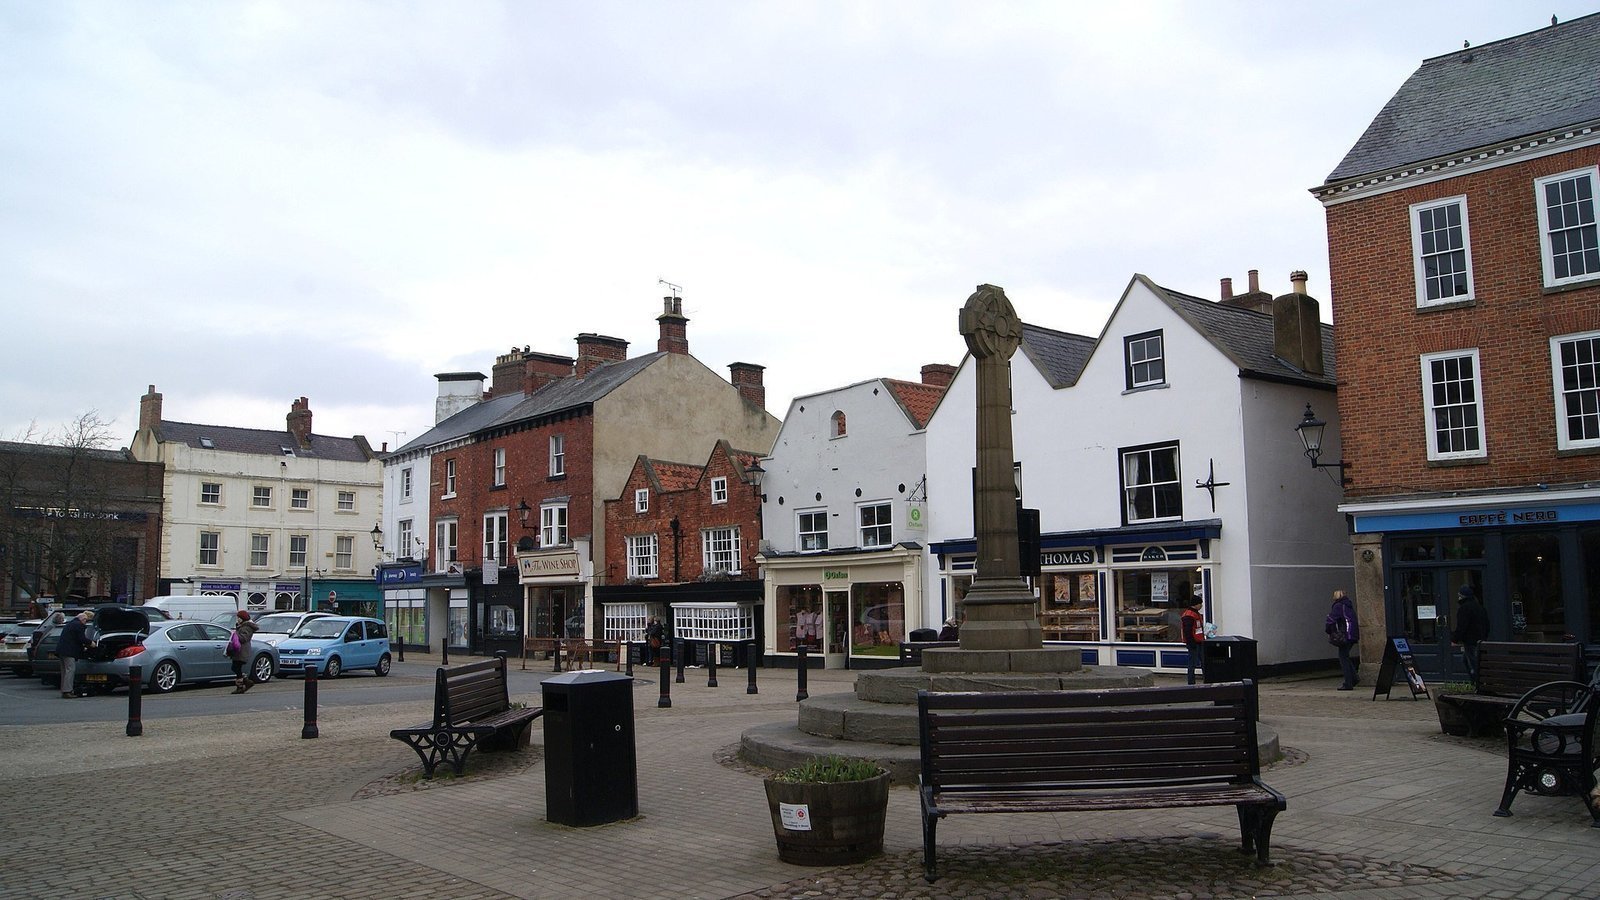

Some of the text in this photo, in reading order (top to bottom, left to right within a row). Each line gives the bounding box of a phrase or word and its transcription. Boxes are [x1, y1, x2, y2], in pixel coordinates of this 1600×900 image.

[1512, 510, 1557, 521] NERO
[1040, 551, 1090, 565] THOMAS
[531, 558, 577, 571] The WINE SHOP
[832, 571, 848, 579] Oxfam
